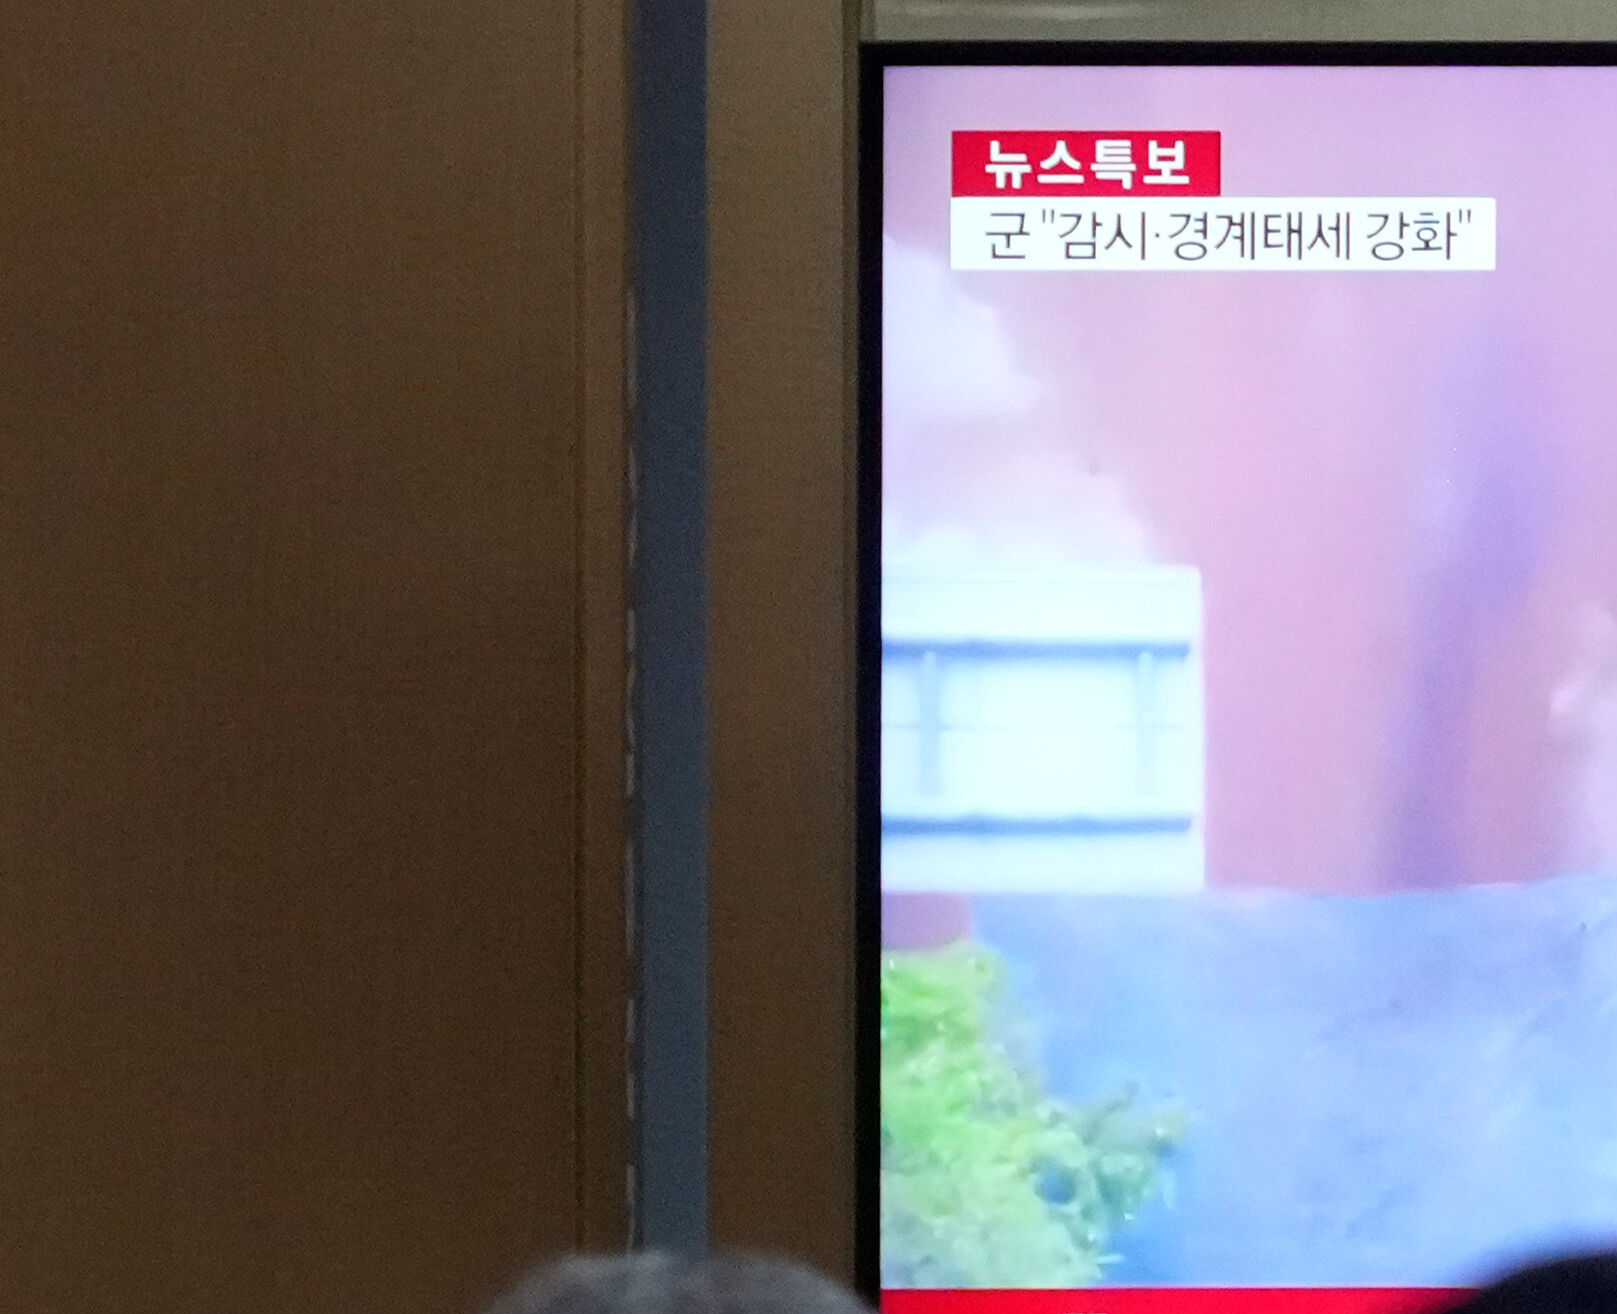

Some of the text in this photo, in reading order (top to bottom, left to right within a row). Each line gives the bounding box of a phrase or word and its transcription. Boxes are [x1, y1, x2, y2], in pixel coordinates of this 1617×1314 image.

[985, 140, 1191, 190] 뉴스특보
[985, 212, 1032, 260] 군
[1366, 210, 1473, 261] 강화"
